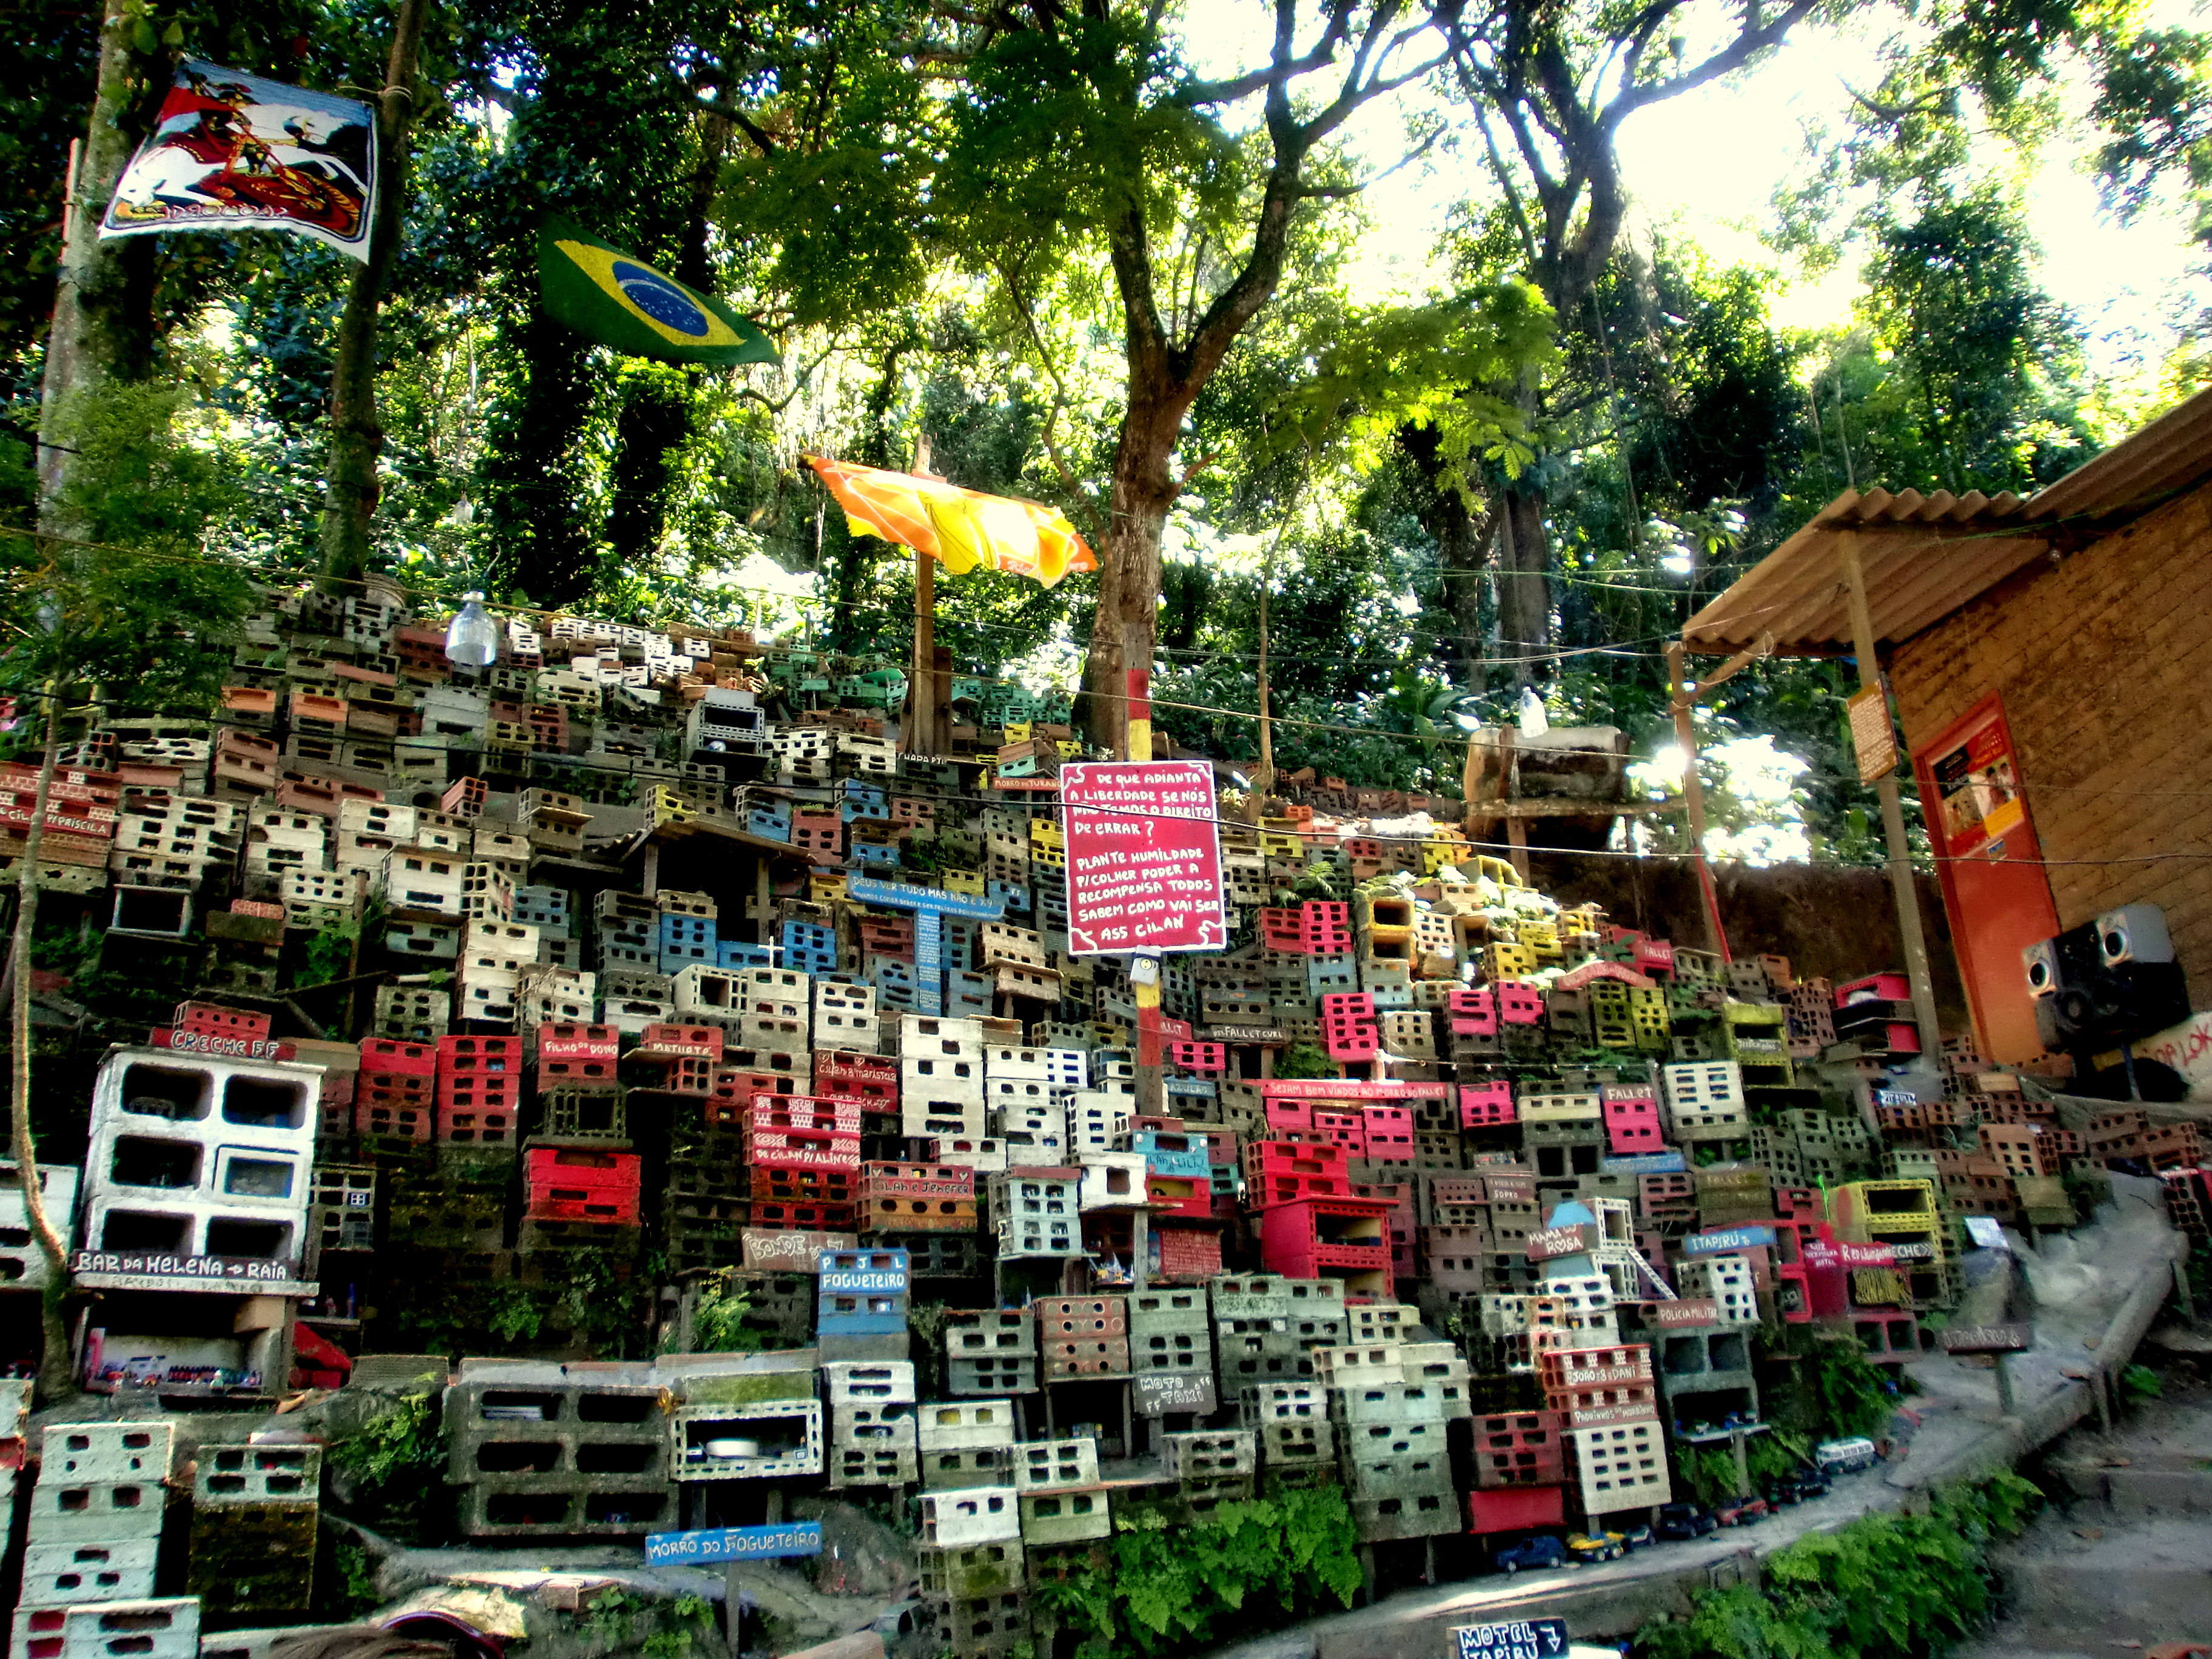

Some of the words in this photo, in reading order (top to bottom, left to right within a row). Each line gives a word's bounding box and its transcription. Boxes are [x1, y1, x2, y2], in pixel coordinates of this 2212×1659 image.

[1070, 791, 1079, 801] A
[1189, 863, 1199, 873] A
[900, 883, 926, 896] TUDO
[928, 888, 947, 900] MAS
[1167, 879, 1213, 892] TODOS
[1127, 899, 1165, 914] COMO
[1101, 926, 1128, 940] ASS
[170, 1030, 247, 1055] CRECHE
[589, 1044, 618, 1055] DONO
[74, 1252, 120, 1272] BAR
[123, 1258, 142, 1270] DA
[822, 1257, 831, 1270] P
[857, 1257, 868, 1269] J
[894, 1258, 903, 1269] L
[1140, 1377, 1184, 1392] MOTO
[648, 1540, 698, 1560] MORRO
[702, 1541, 720, 1554] DO
[1459, 1622, 1538, 1649] MOTEL
